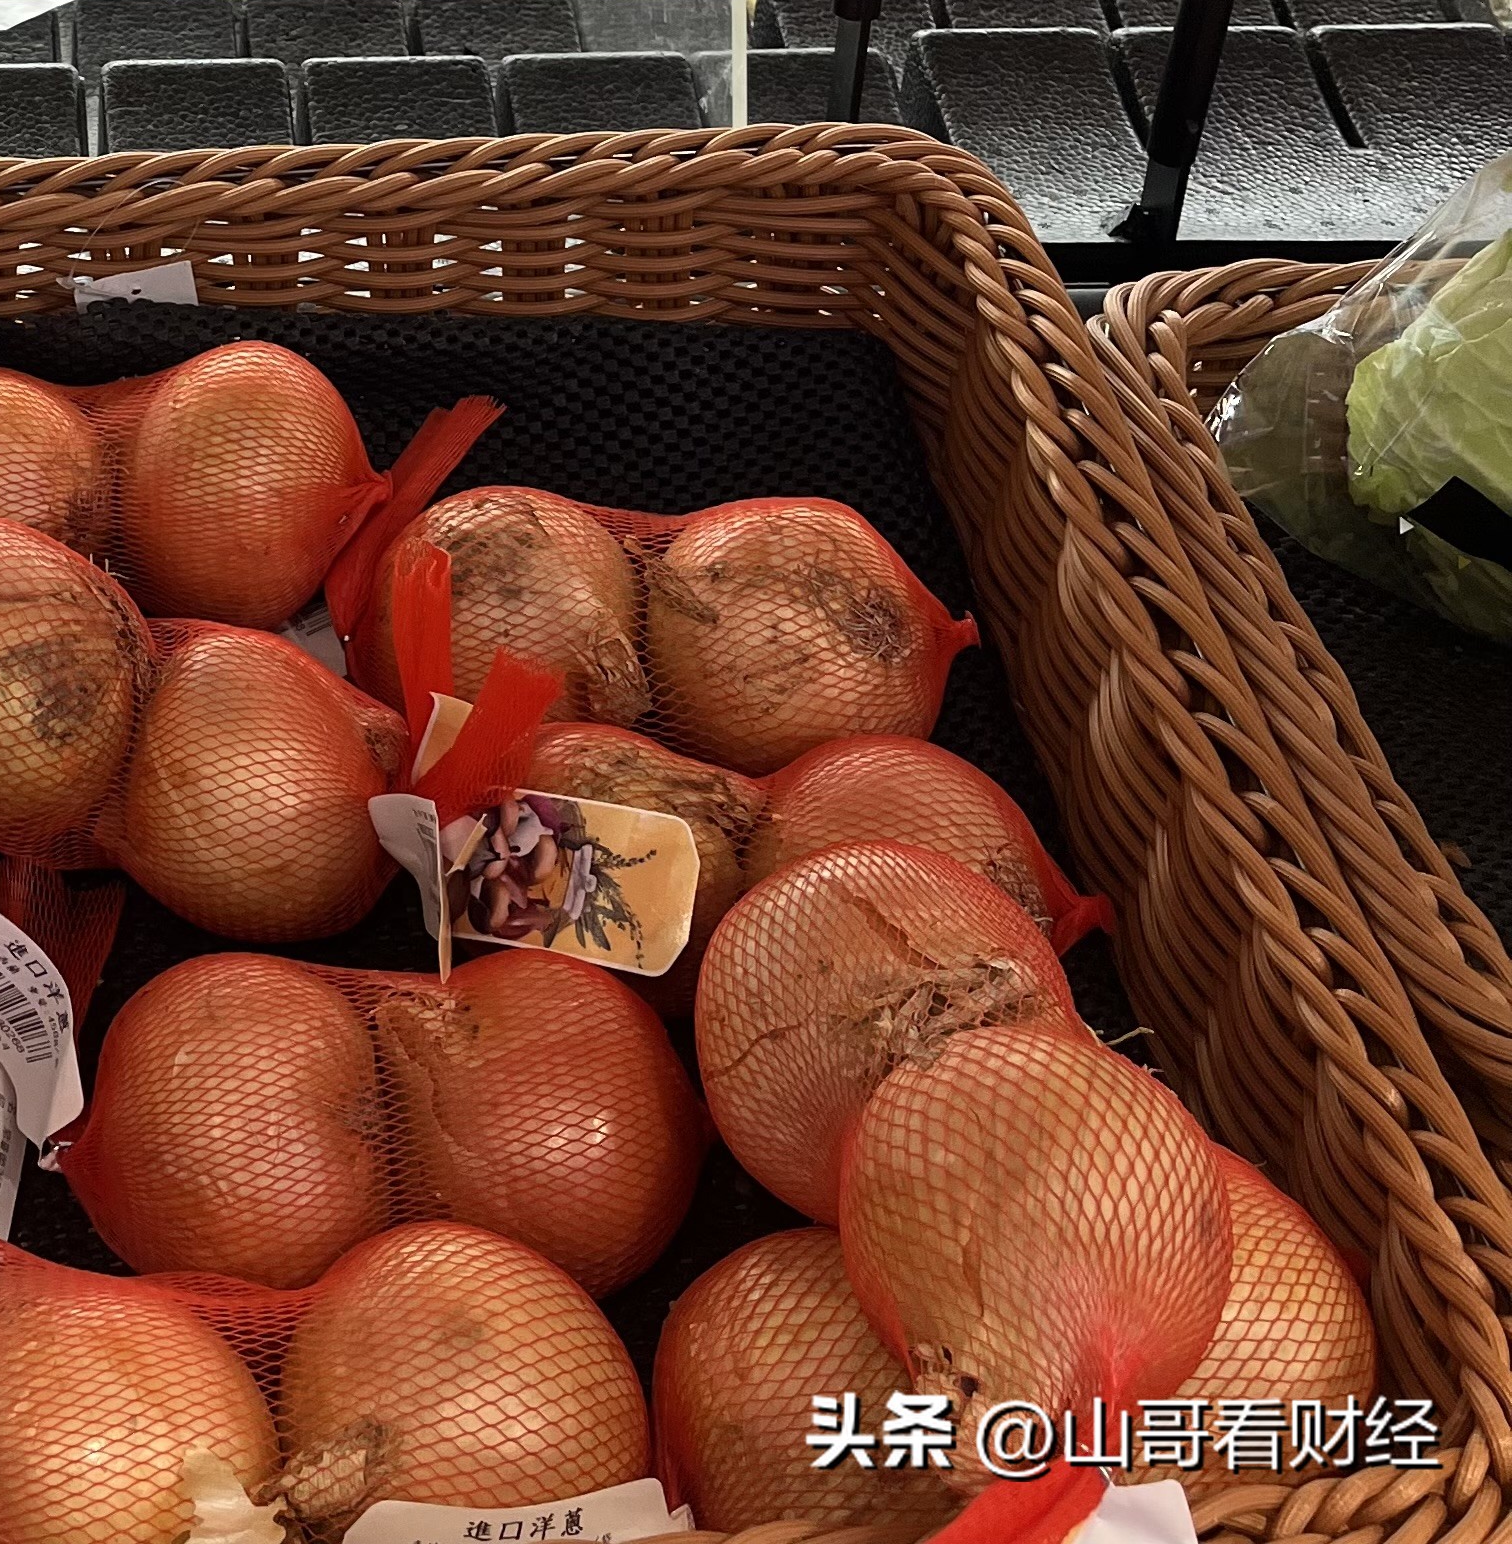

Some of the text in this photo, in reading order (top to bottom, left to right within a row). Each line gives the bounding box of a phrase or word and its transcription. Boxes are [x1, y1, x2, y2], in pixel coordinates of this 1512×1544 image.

[2, 937, 72, 1034] 進口洋蔥
[462, 1506, 585, 1543] 進口洋蔥
